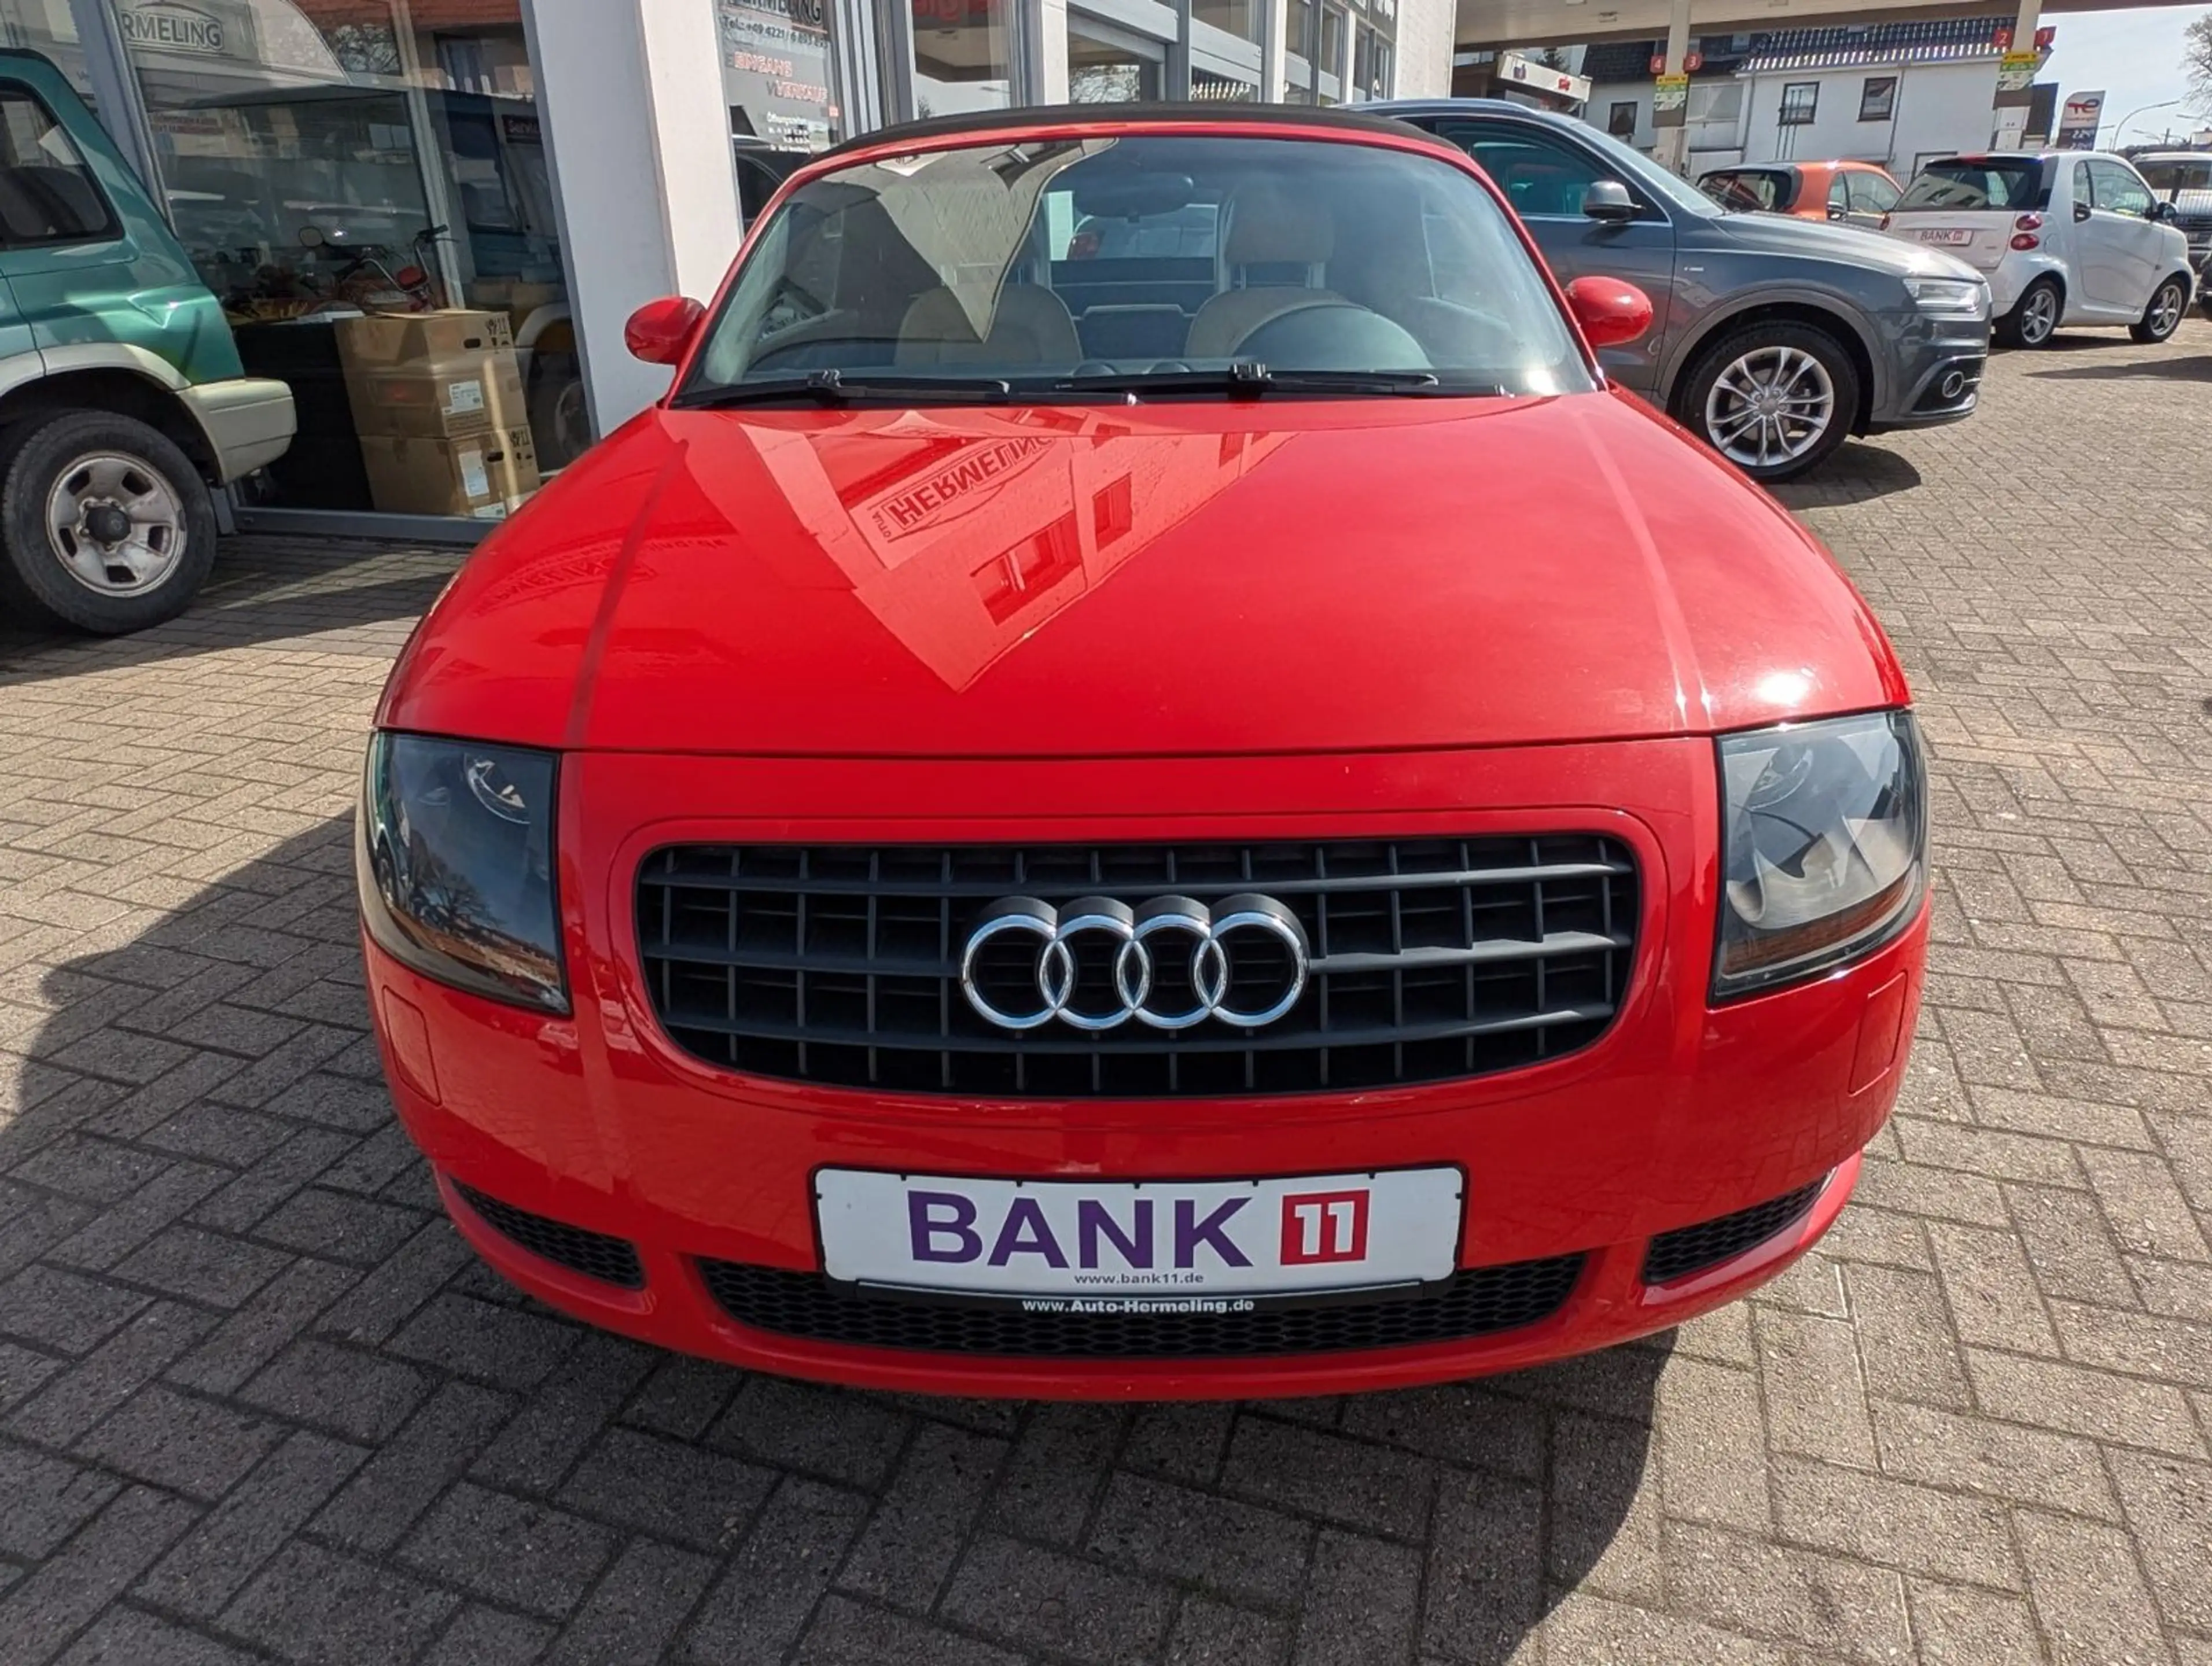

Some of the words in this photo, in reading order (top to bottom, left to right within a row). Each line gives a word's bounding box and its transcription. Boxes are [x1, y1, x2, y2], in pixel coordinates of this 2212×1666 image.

[2000, 32, 2008, 44] 2
[1655, 58, 1662, 69] 4
[1689, 56, 1696, 67] 3
[1920, 230, 1951, 241] BANK
[907, 1189, 1254, 1269] BANK
[1294, 1200, 1356, 1256] 11
[1074, 1273, 1204, 1285] www.bank11.de
[1022, 1299, 1254, 1314] www.Auto-Hermeling.de
